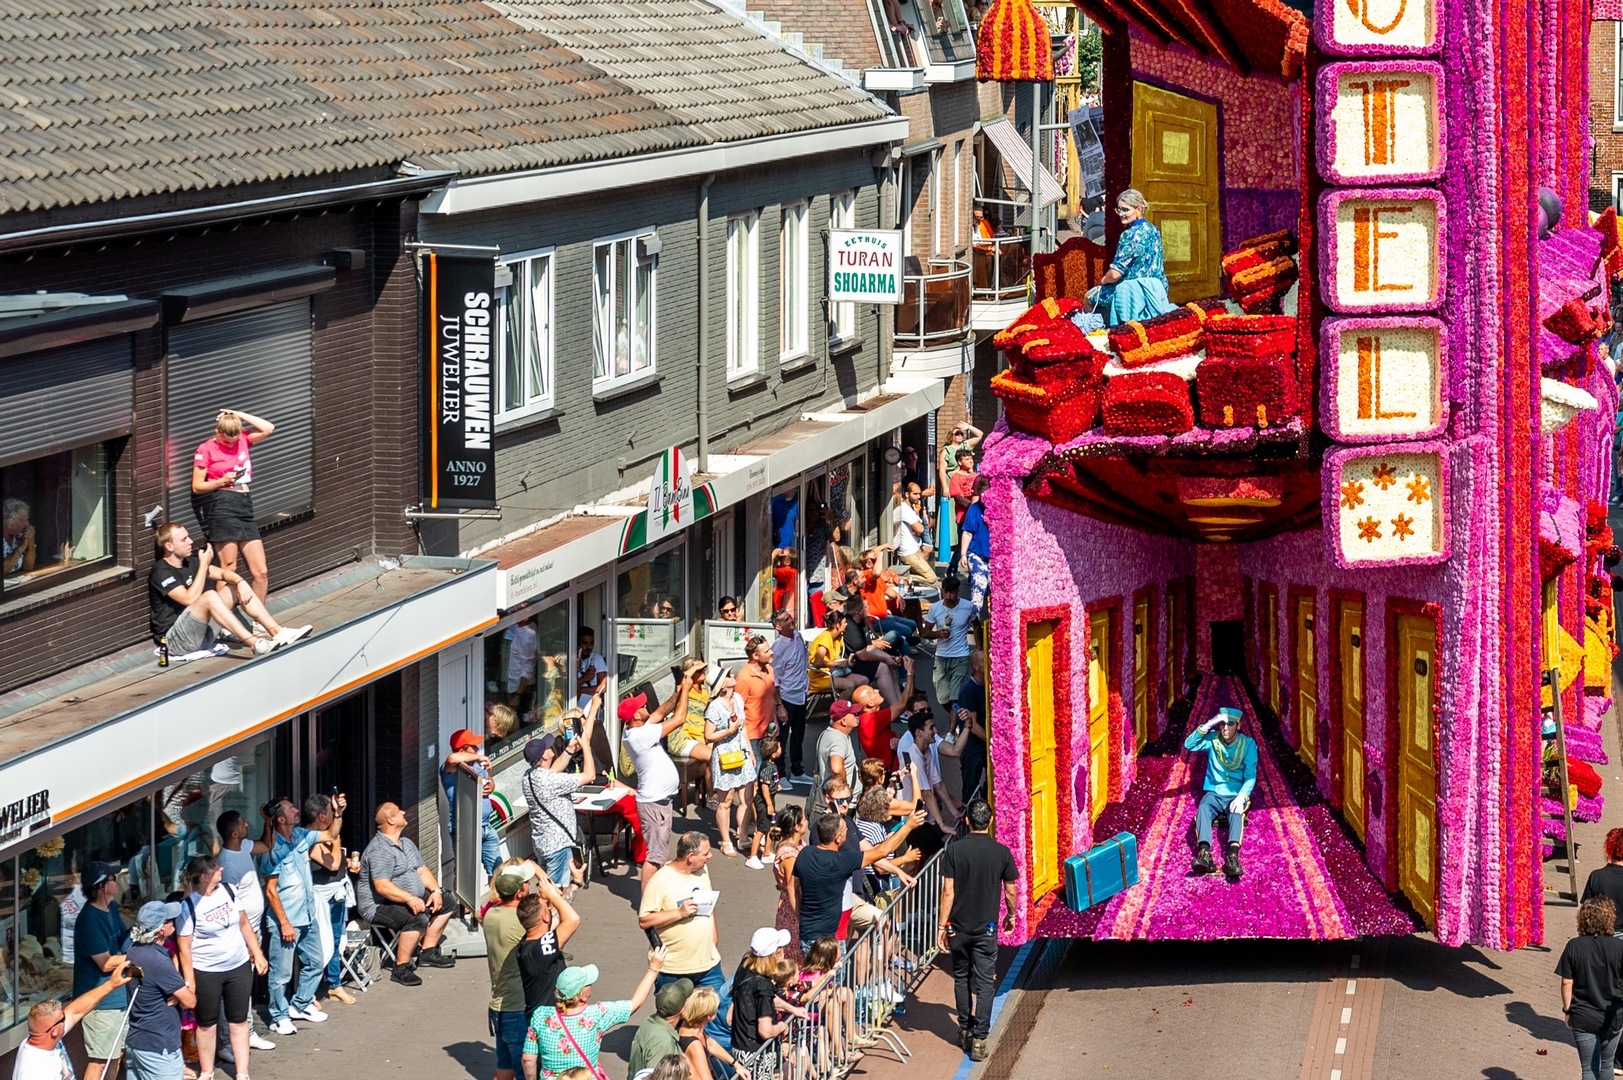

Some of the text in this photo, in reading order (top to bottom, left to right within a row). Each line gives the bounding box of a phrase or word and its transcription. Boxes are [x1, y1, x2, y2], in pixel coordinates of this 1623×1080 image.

[845, 236, 887, 249] EETHUIS
[838, 251, 893, 267] TURAN
[834, 271, 896, 294] SHOARMA
[440, 315, 460, 425] JUWELIER
[463, 292, 491, 449] SCHRAUWEN
[446, 460, 487, 473] ANNO
[453, 474, 482, 487] 1927
[205, 905, 233, 922] GUESS
